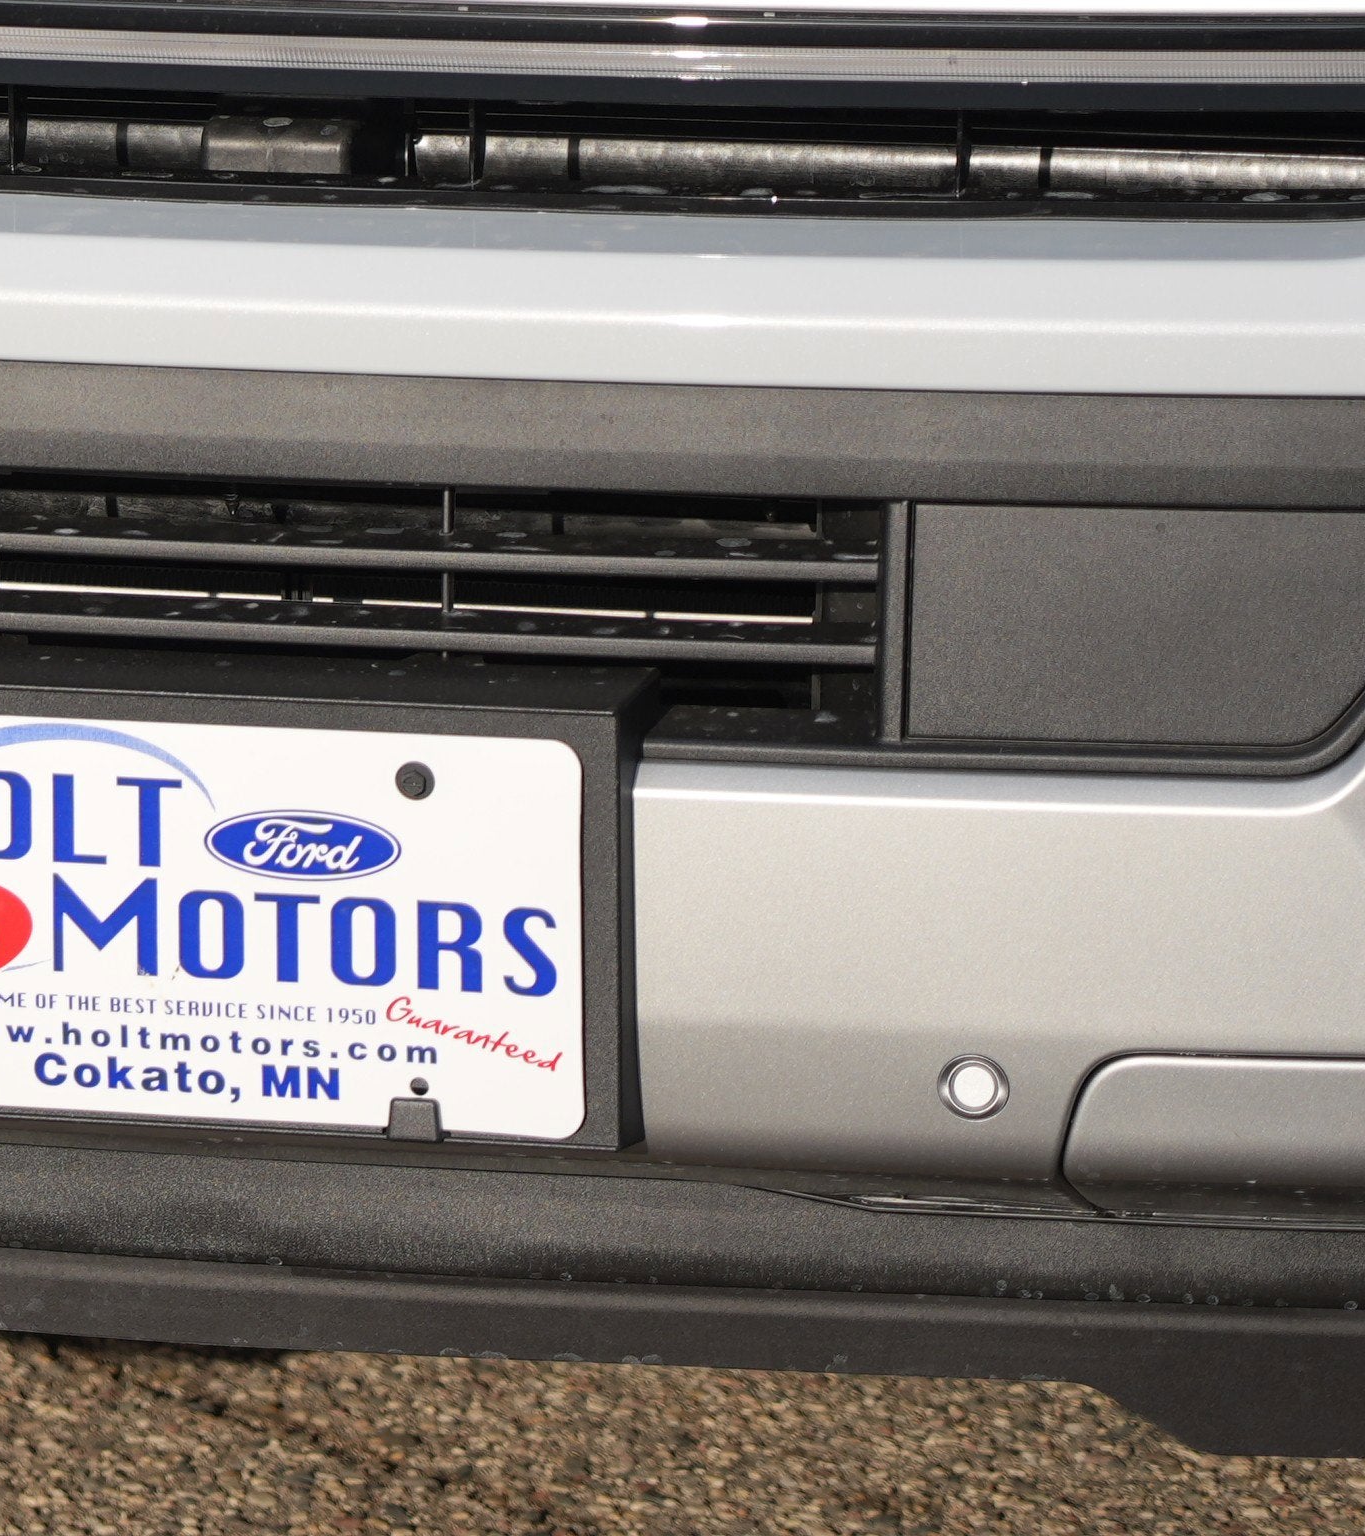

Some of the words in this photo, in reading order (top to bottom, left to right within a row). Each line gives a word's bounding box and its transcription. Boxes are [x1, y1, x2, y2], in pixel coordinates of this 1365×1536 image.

[242, 819, 362, 870] Ford
[53, 872, 557, 997] MOTORS
[35, 993, 58, 1009] OF
[66, 995, 101, 1011] THE
[110, 997, 157, 1014] BEST
[165, 999, 248, 1020] SERVICE
[257, 1004, 316, 1022] SINCE
[327, 1007, 376, 1025] 1950
[386, 996, 563, 1071] Guaranteed
[34, 1052, 241, 1103] Cokato,
[262, 1064, 340, 1100] MN
